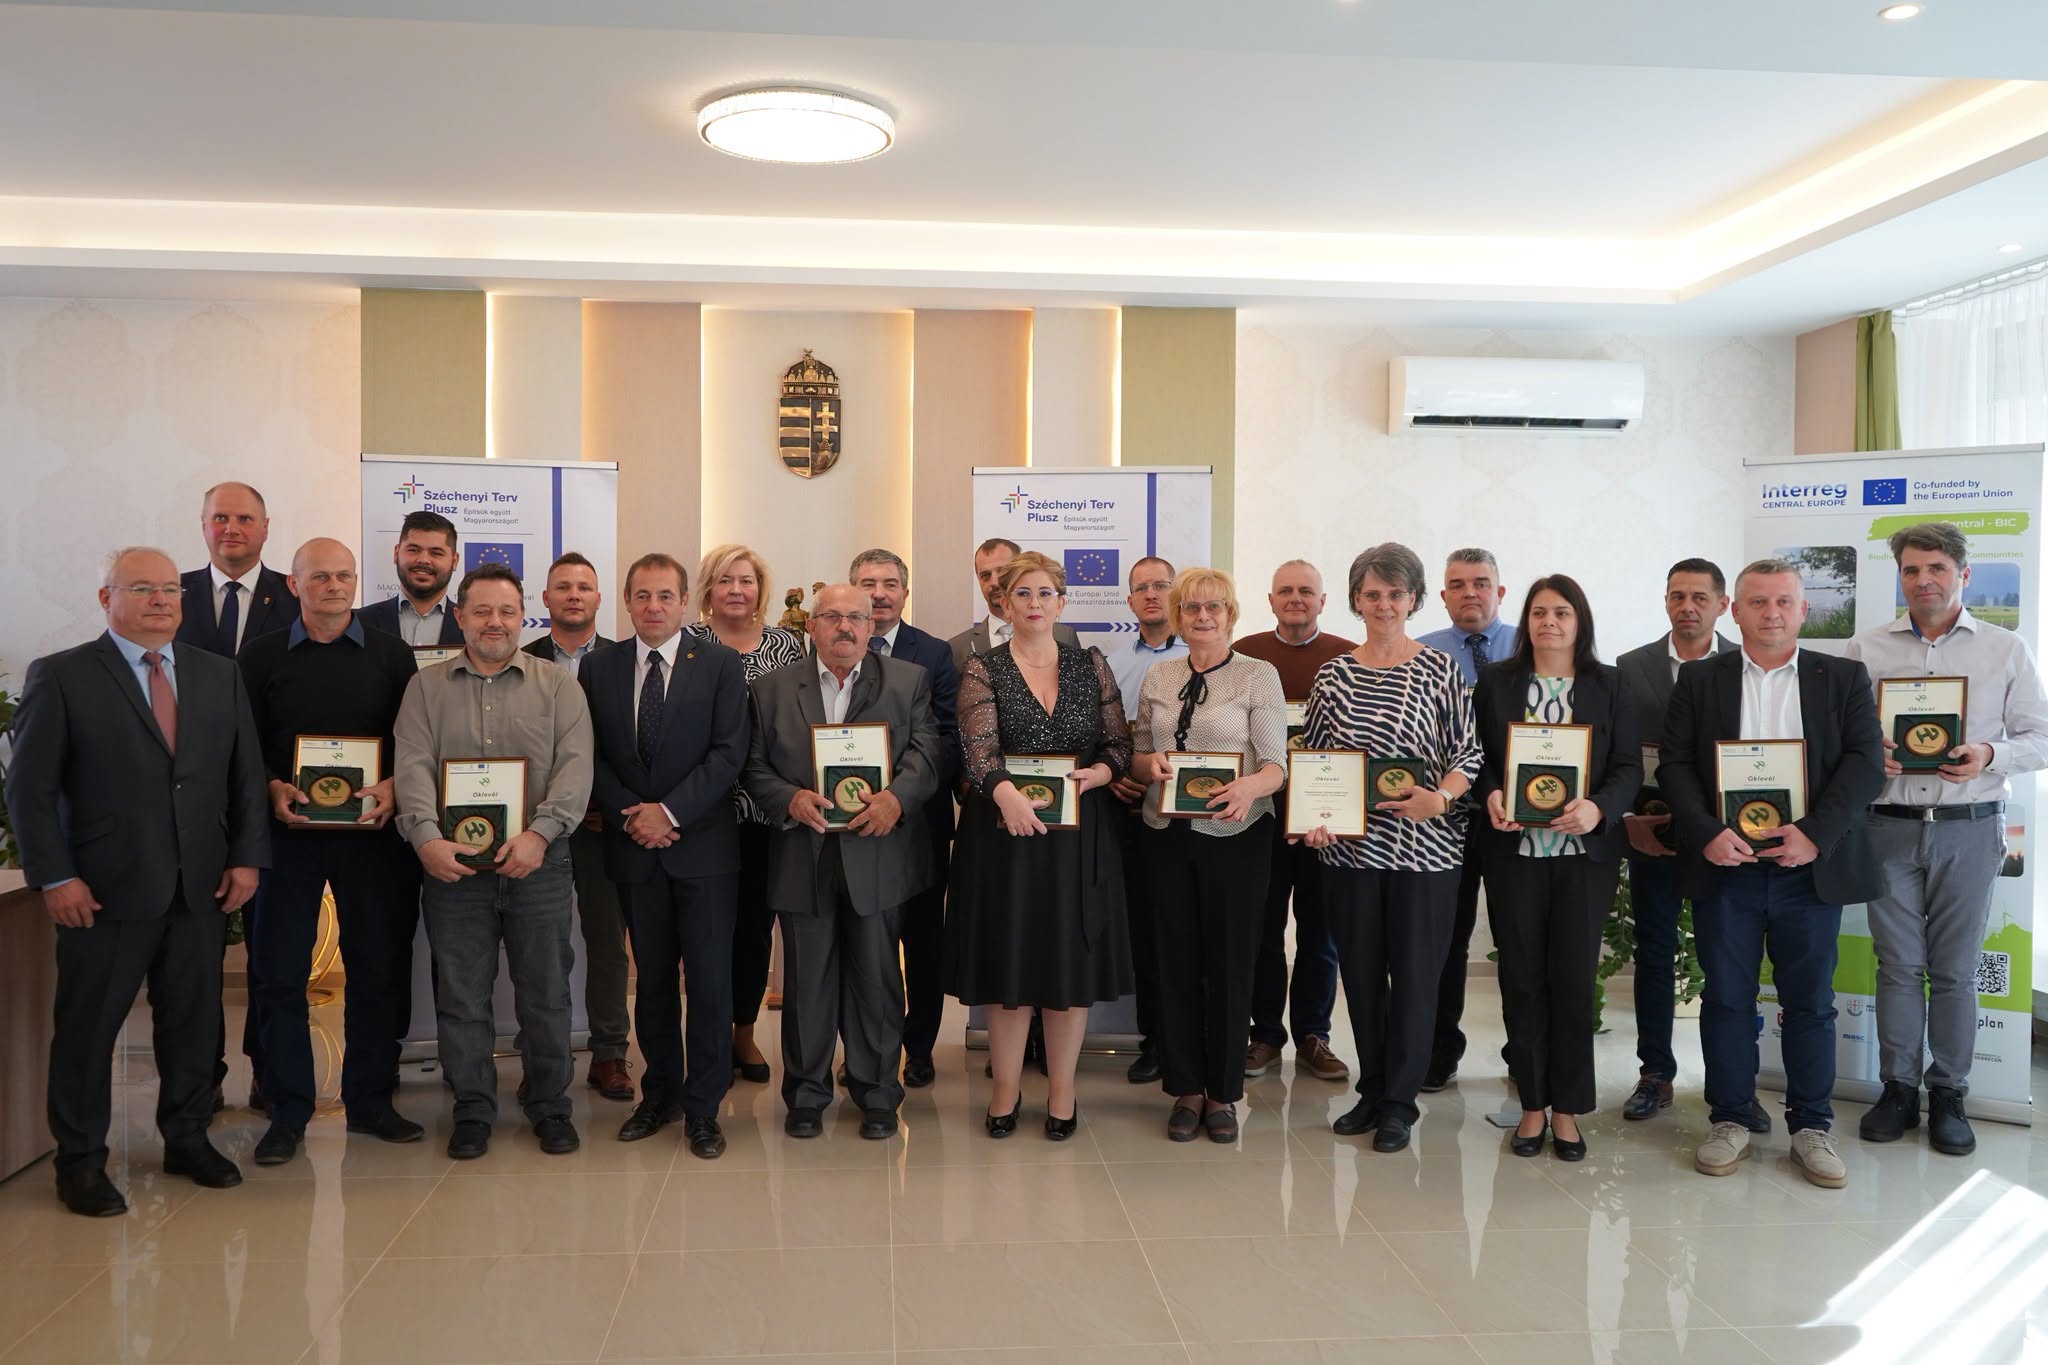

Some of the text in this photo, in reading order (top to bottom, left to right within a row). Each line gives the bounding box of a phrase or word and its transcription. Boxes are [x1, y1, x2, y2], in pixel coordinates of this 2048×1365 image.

[1913, 479, 1981, 490] Co-funded by
[1762, 482, 1847, 499] Interreg
[1913, 489, 2013, 500] the European Union
[423, 490, 518, 504] Széchenyi Terv
[423, 503, 458, 514] Plusz
[1027, 499, 1115, 511] Széchenyi Terv
[1762, 499, 1847, 509] CENTRAL EUROPE
[463, 516, 519, 525] Magyarországot!
[1027, 512, 1058, 522] Plusz
[1995, 518, 2017, 527] BIC
[1977, 1015, 2004, 1030] plan
